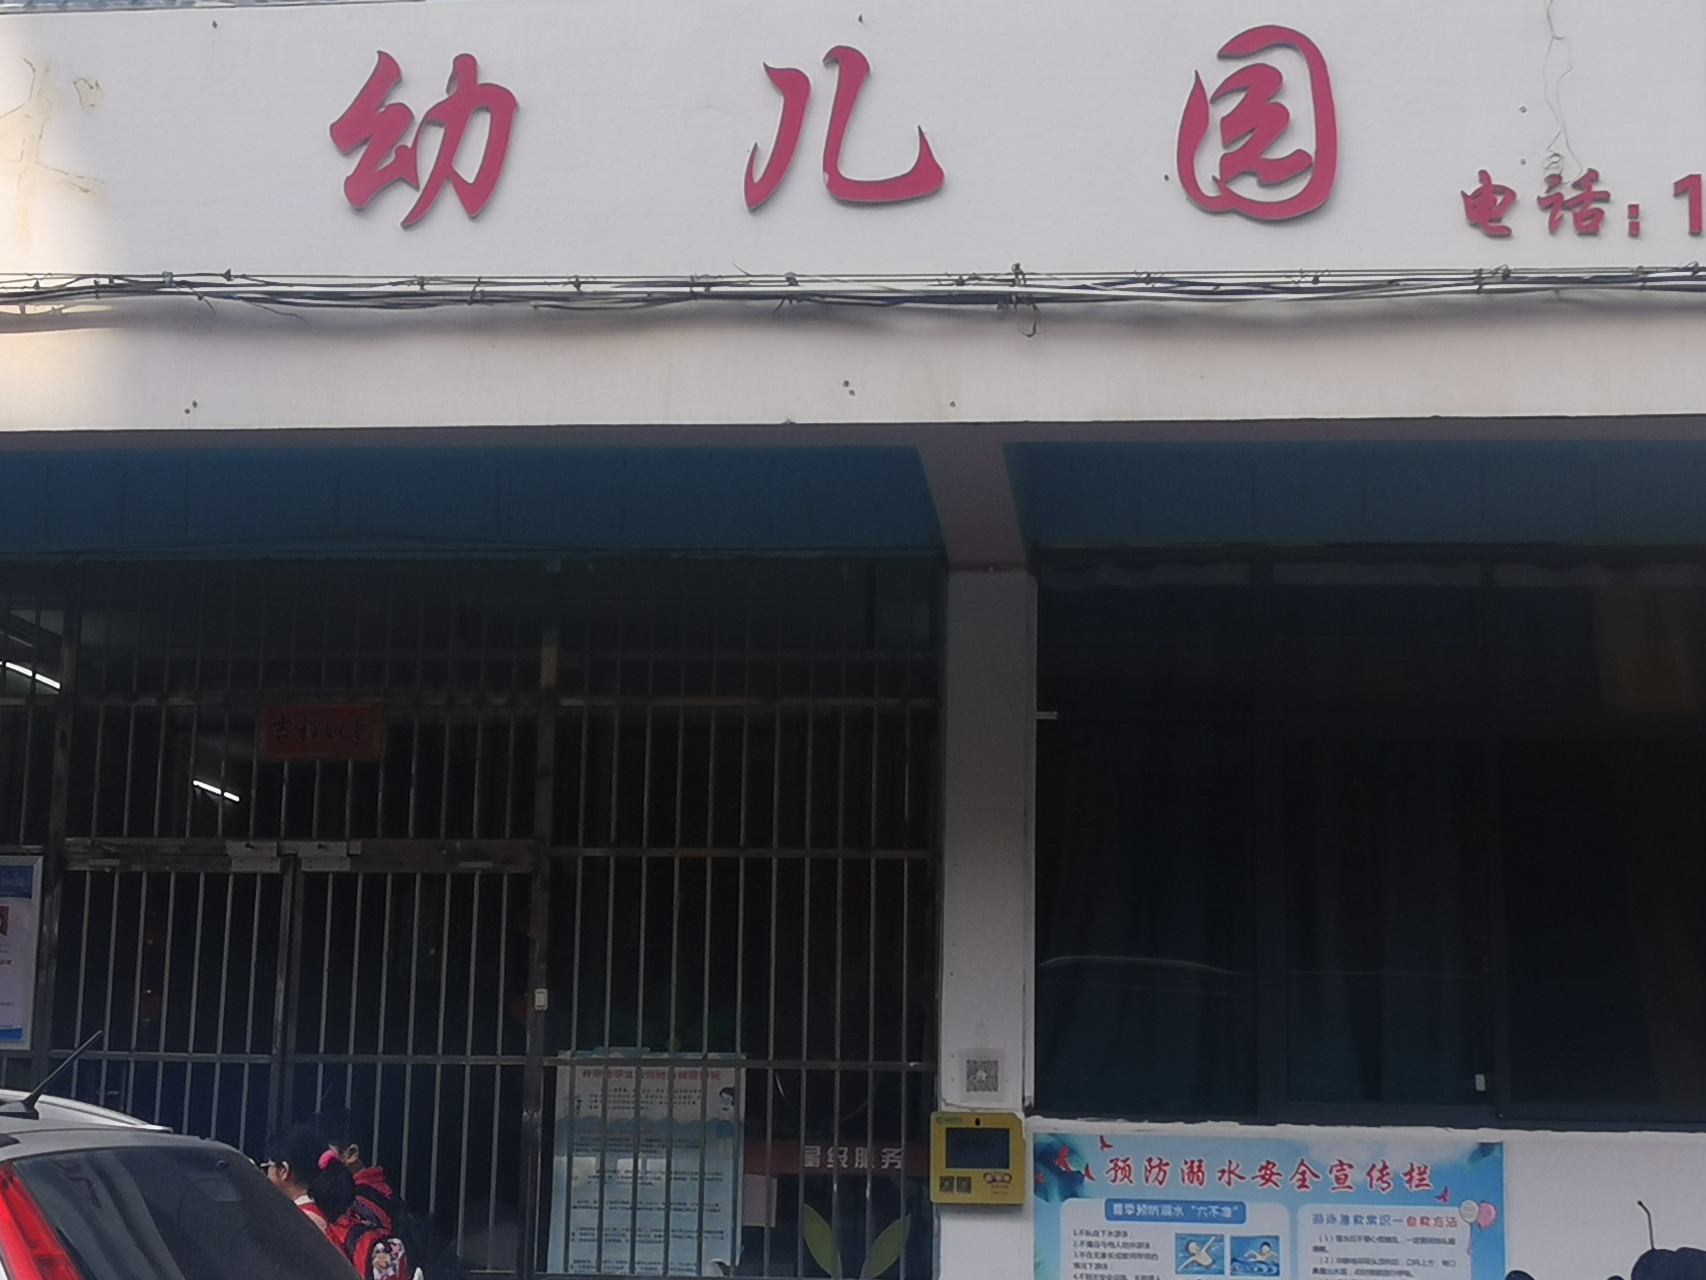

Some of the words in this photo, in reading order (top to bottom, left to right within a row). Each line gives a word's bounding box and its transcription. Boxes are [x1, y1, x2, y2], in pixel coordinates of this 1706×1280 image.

[1103, 1155, 1435, 1194] 预防溺水安全宣传栏
